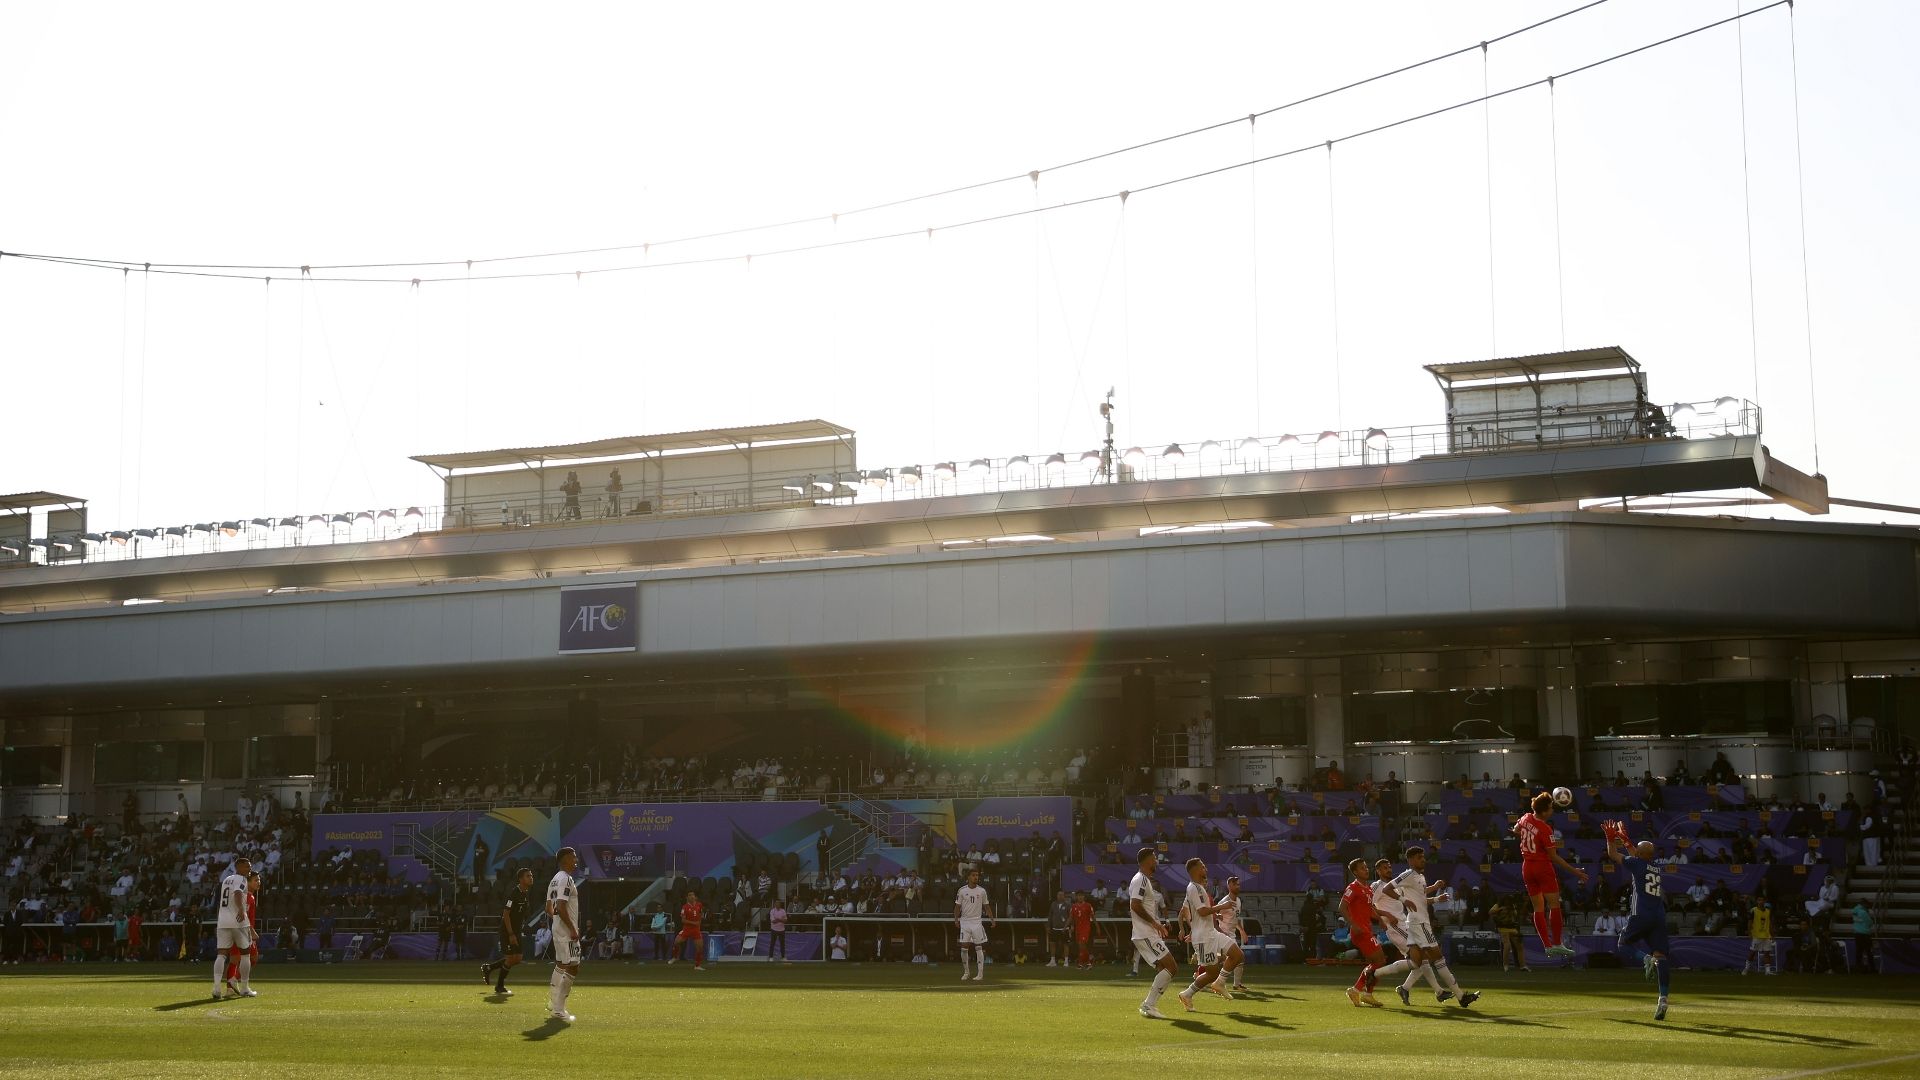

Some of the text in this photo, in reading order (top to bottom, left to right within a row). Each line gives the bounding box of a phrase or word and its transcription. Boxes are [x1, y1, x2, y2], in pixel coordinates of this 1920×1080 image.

[568, 603, 619, 632] AFC
[628, 816, 673, 825] ASIAN CUP
[630, 824, 669, 833] QATAR 2023
[325, 830, 384, 842] #AsianCup2023
[1520, 827, 1536, 853] 20
[222, 887, 230, 907] 9
[1155, 942, 1165, 952] 2
[1205, 952, 1215, 963] 20
